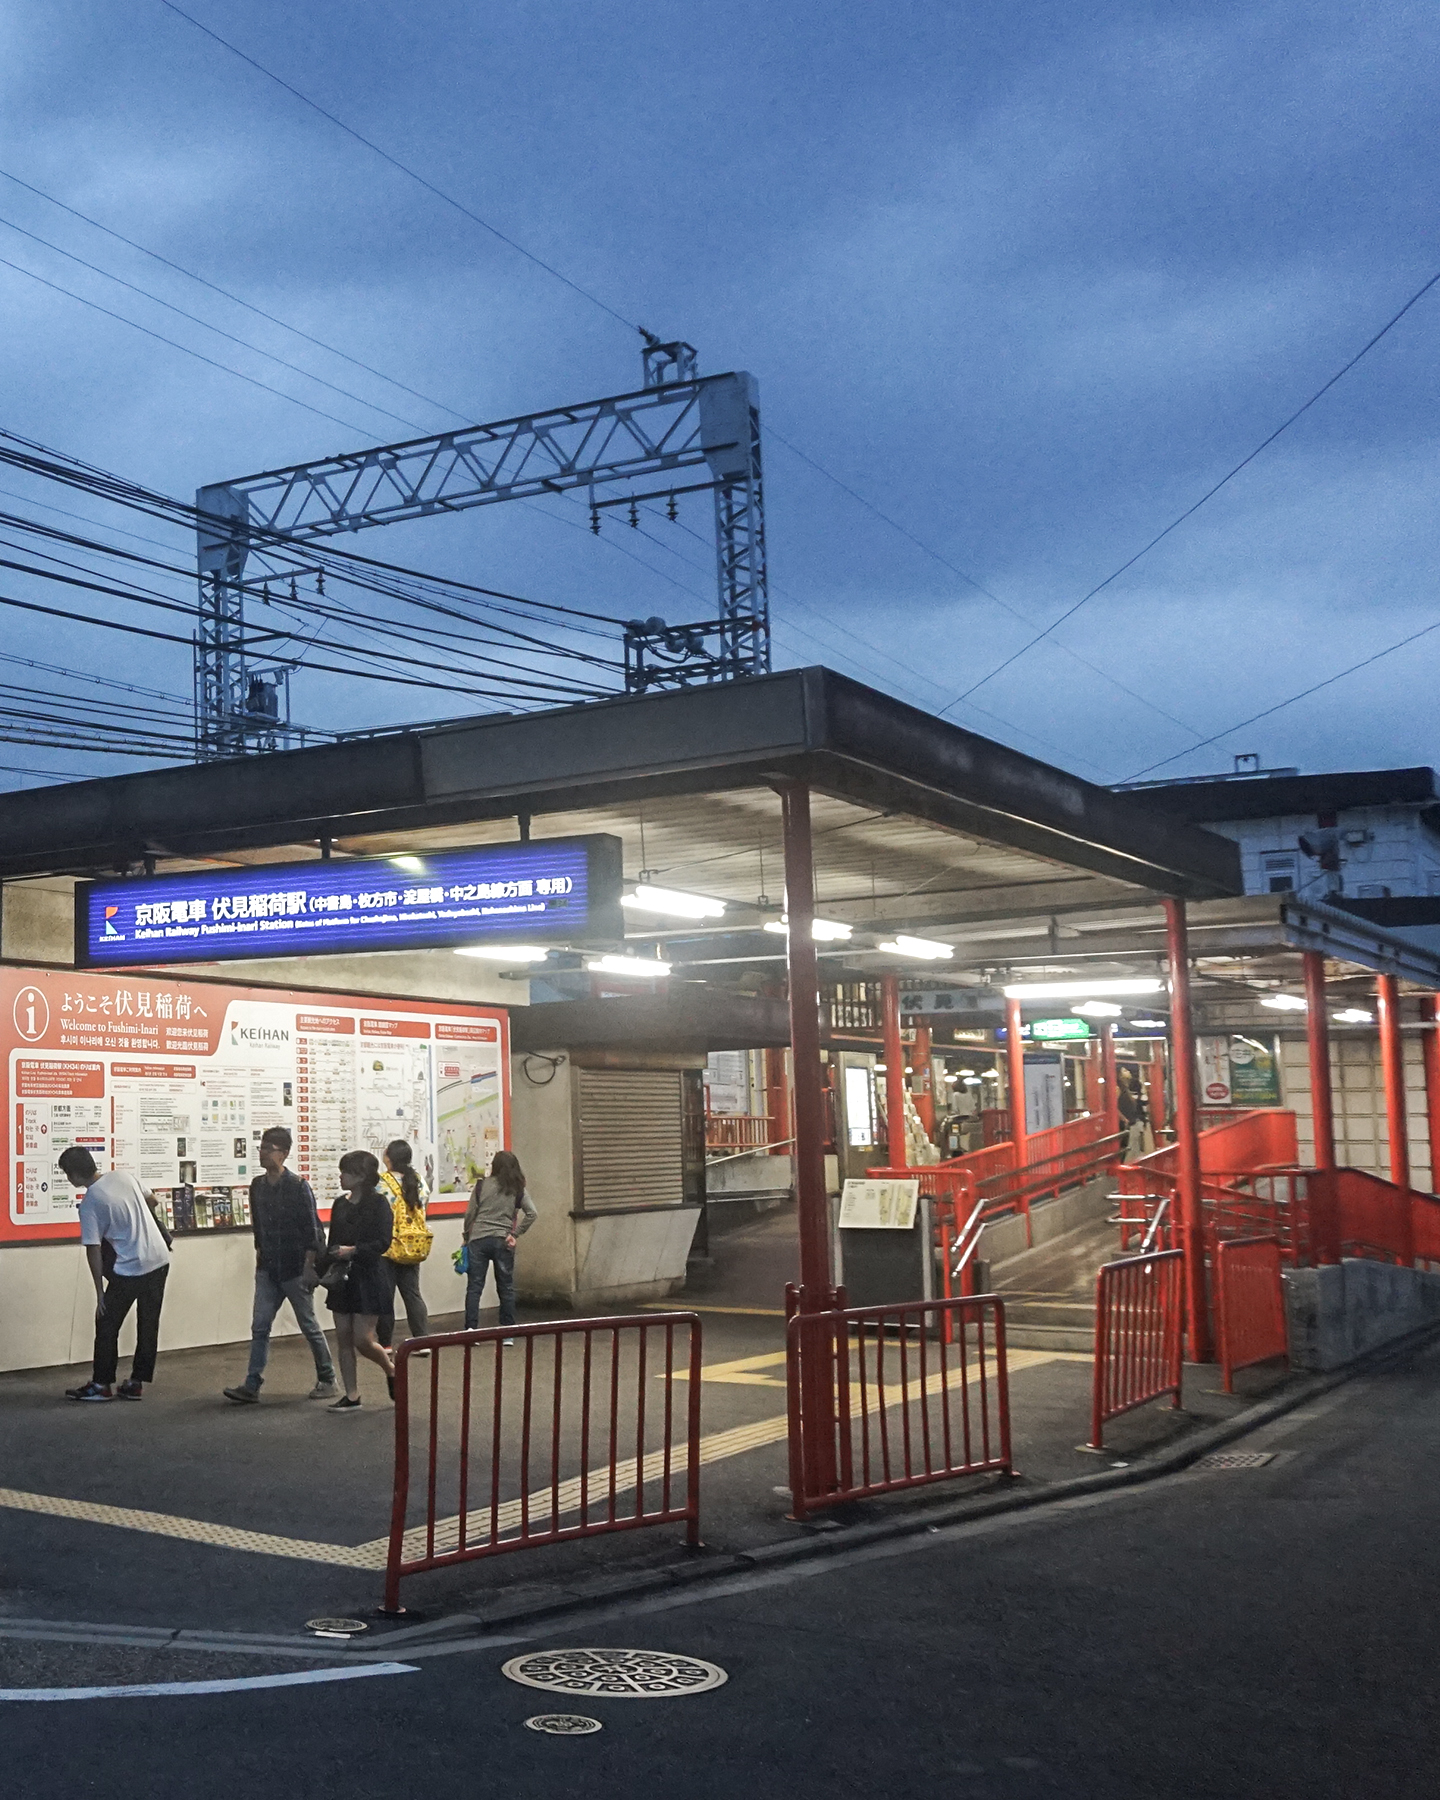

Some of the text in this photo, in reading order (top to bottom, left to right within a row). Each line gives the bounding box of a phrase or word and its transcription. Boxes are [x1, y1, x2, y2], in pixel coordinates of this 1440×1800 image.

[135, 900, 207, 926] 京阪電車
[212, 891, 307, 920] 伏見稲荷駅
[135, 927, 164, 940] Keihan
[165, 924, 199, 938] Railway
[201, 920, 258, 936] Fushimi-Inari
[260, 918, 294, 931] Station
[60, 989, 208, 1020] ようこそ伏見稲荷へ
[60, 1018, 159, 1035] Welcome to Fushimi-Inari
[60, 1034, 79, 1045] 후시미
[79, 1035, 103, 1047] 이나리에
[104, 1037, 117, 1047] 오신
[118, 1038, 130, 1048] 것을
[18, 1124, 23, 1135] 1
[17, 1183, 23, 1193] 2
